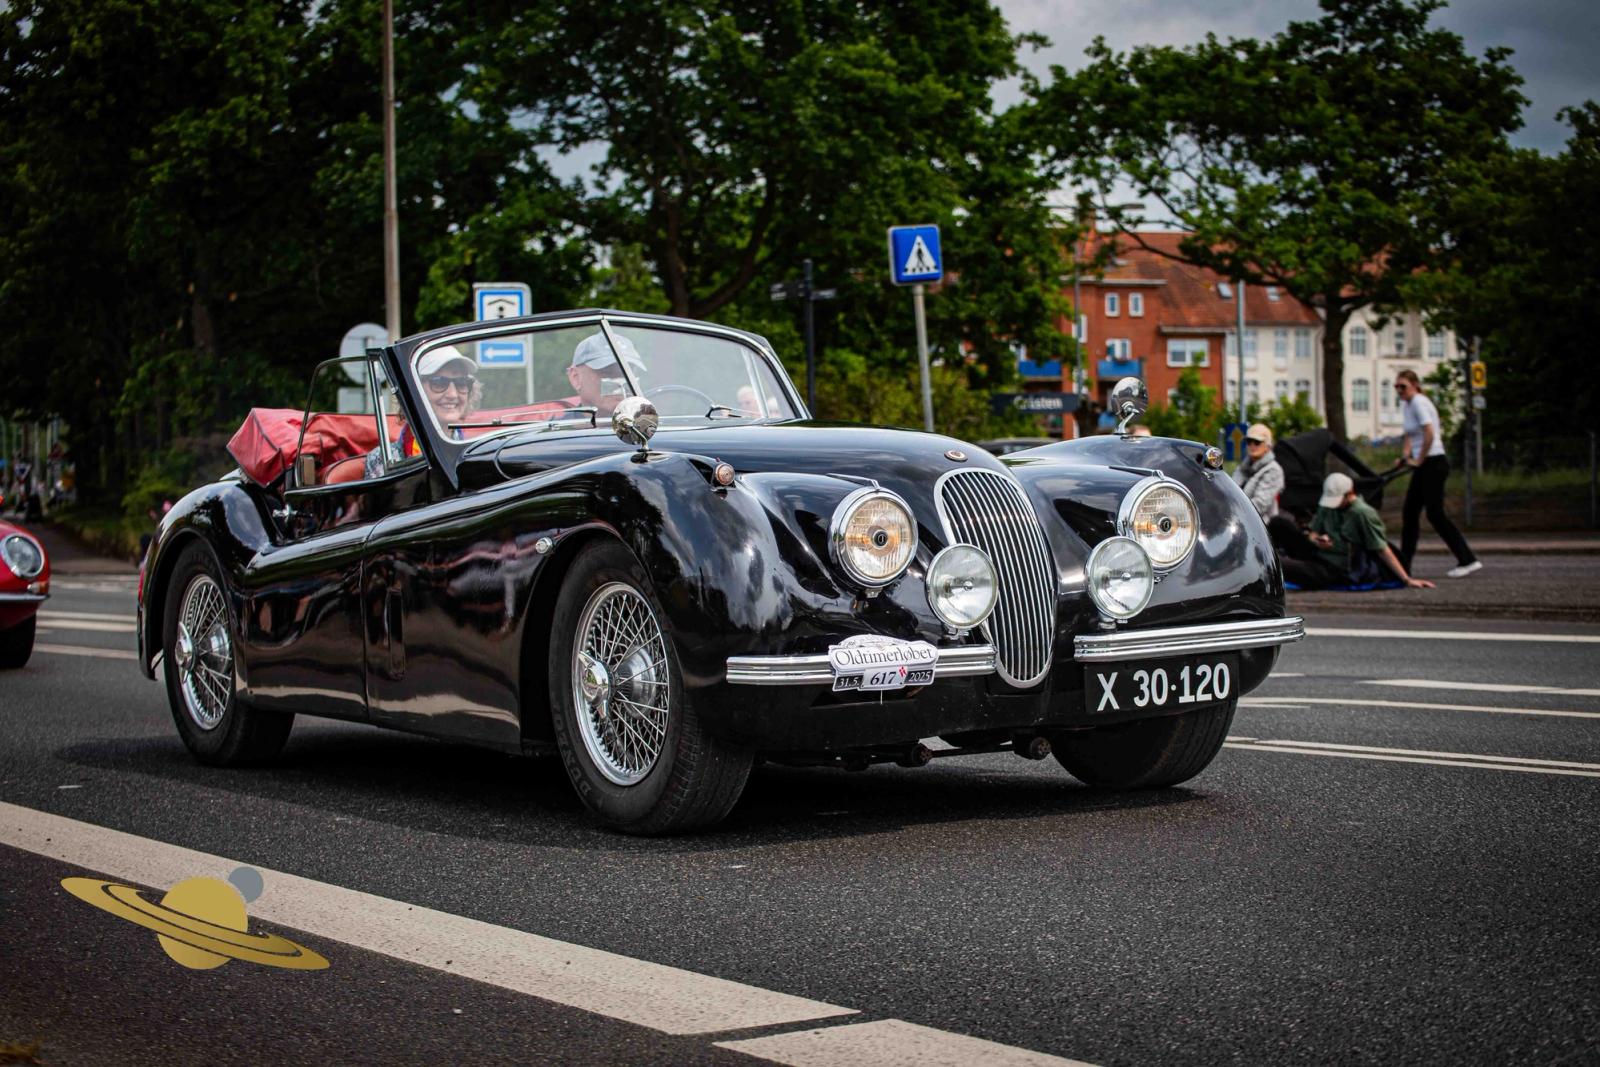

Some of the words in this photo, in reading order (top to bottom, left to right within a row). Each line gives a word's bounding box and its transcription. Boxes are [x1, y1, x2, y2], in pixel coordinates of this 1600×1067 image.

[835, 647, 933, 665] Oldtimerløbet
[870, 672, 897, 685] 617
[909, 671, 930, 682] 2025
[1097, 672, 1120, 712] X
